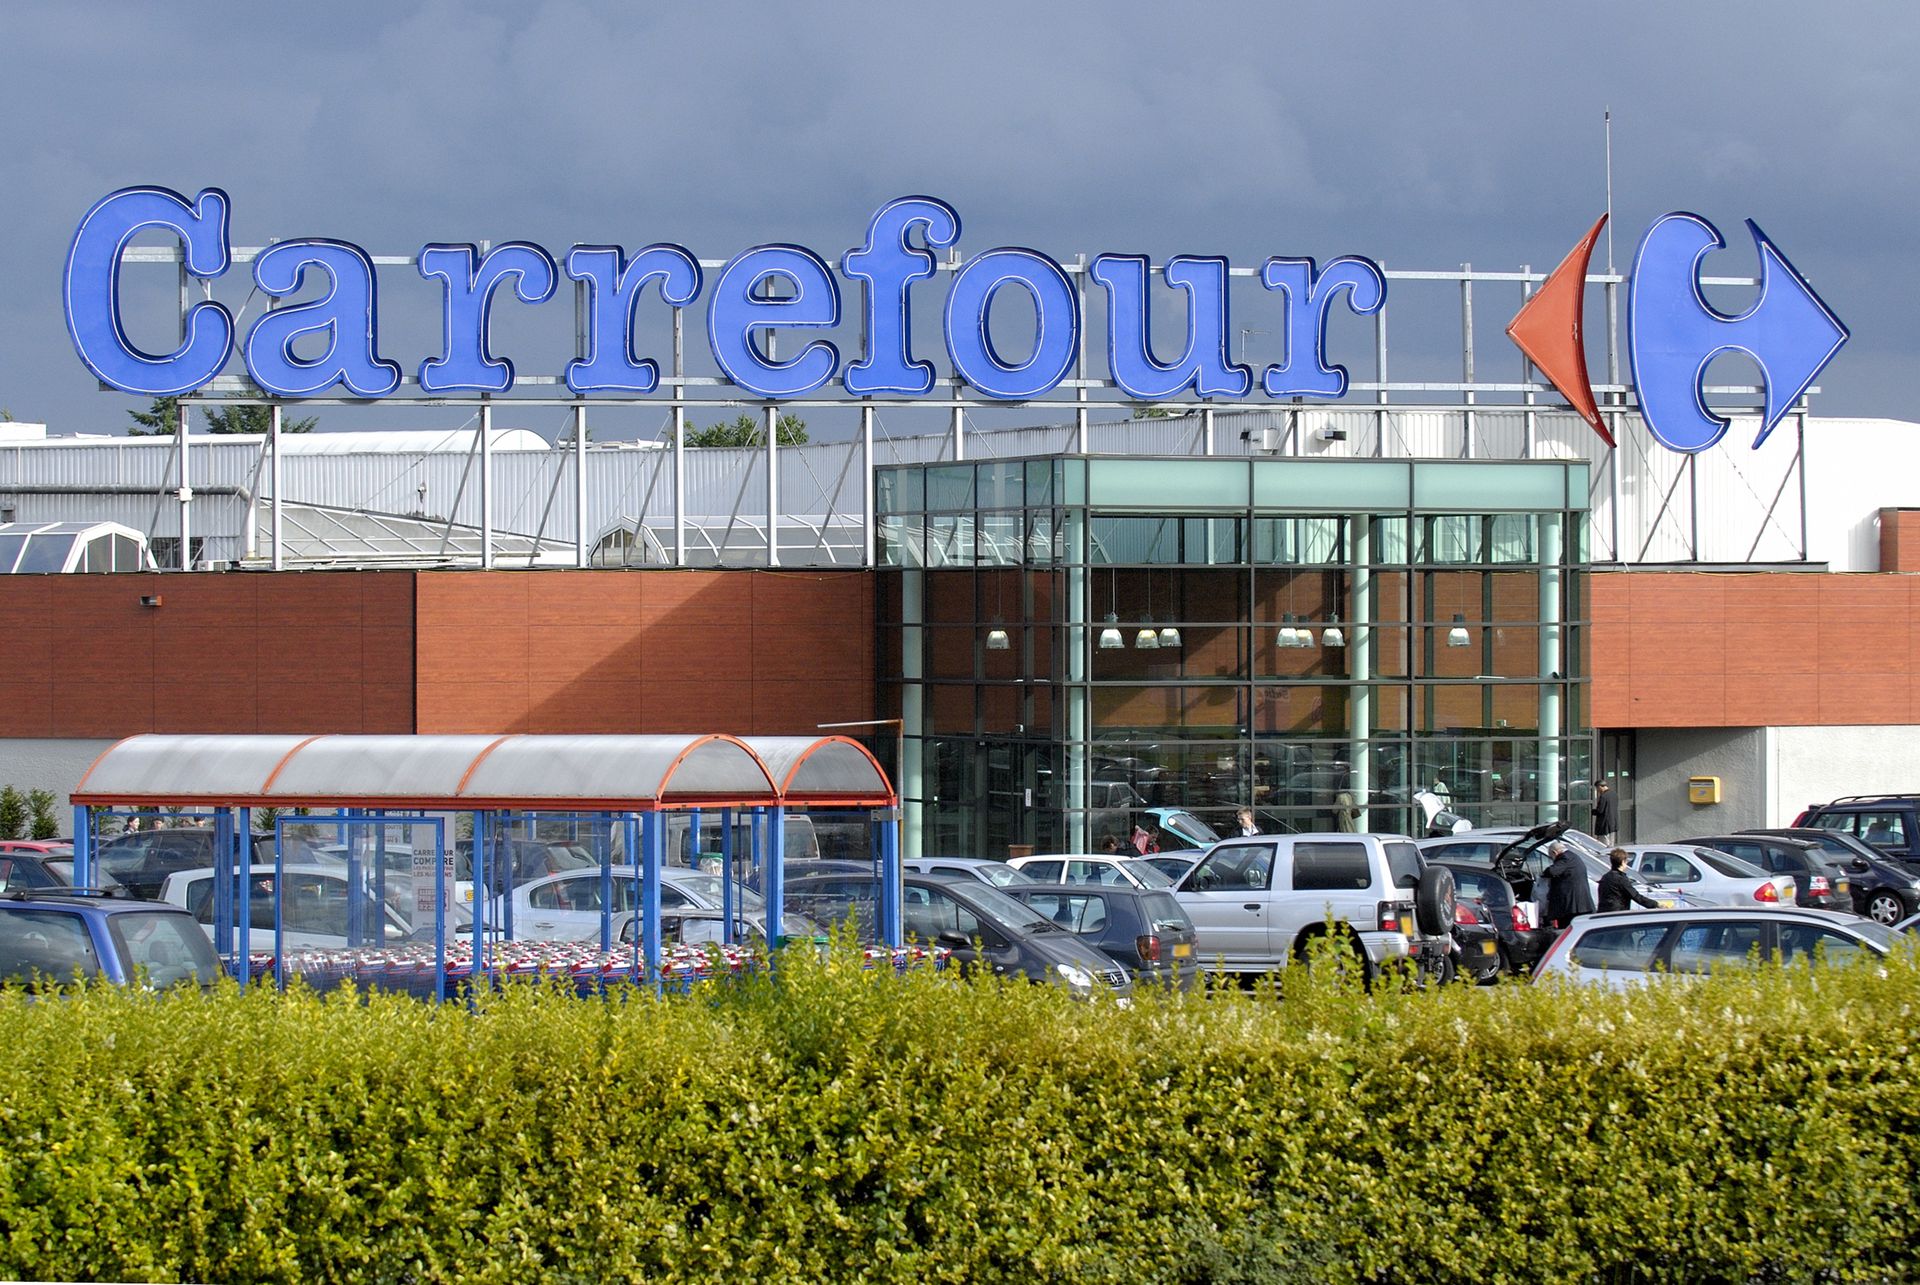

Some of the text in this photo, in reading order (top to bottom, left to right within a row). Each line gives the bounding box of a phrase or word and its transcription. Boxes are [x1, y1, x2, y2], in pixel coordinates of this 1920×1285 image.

[62, 185, 1387, 402] Carrefour
[413, 849, 454, 857] CARREUR
[413, 857, 454, 866] COMPRE
